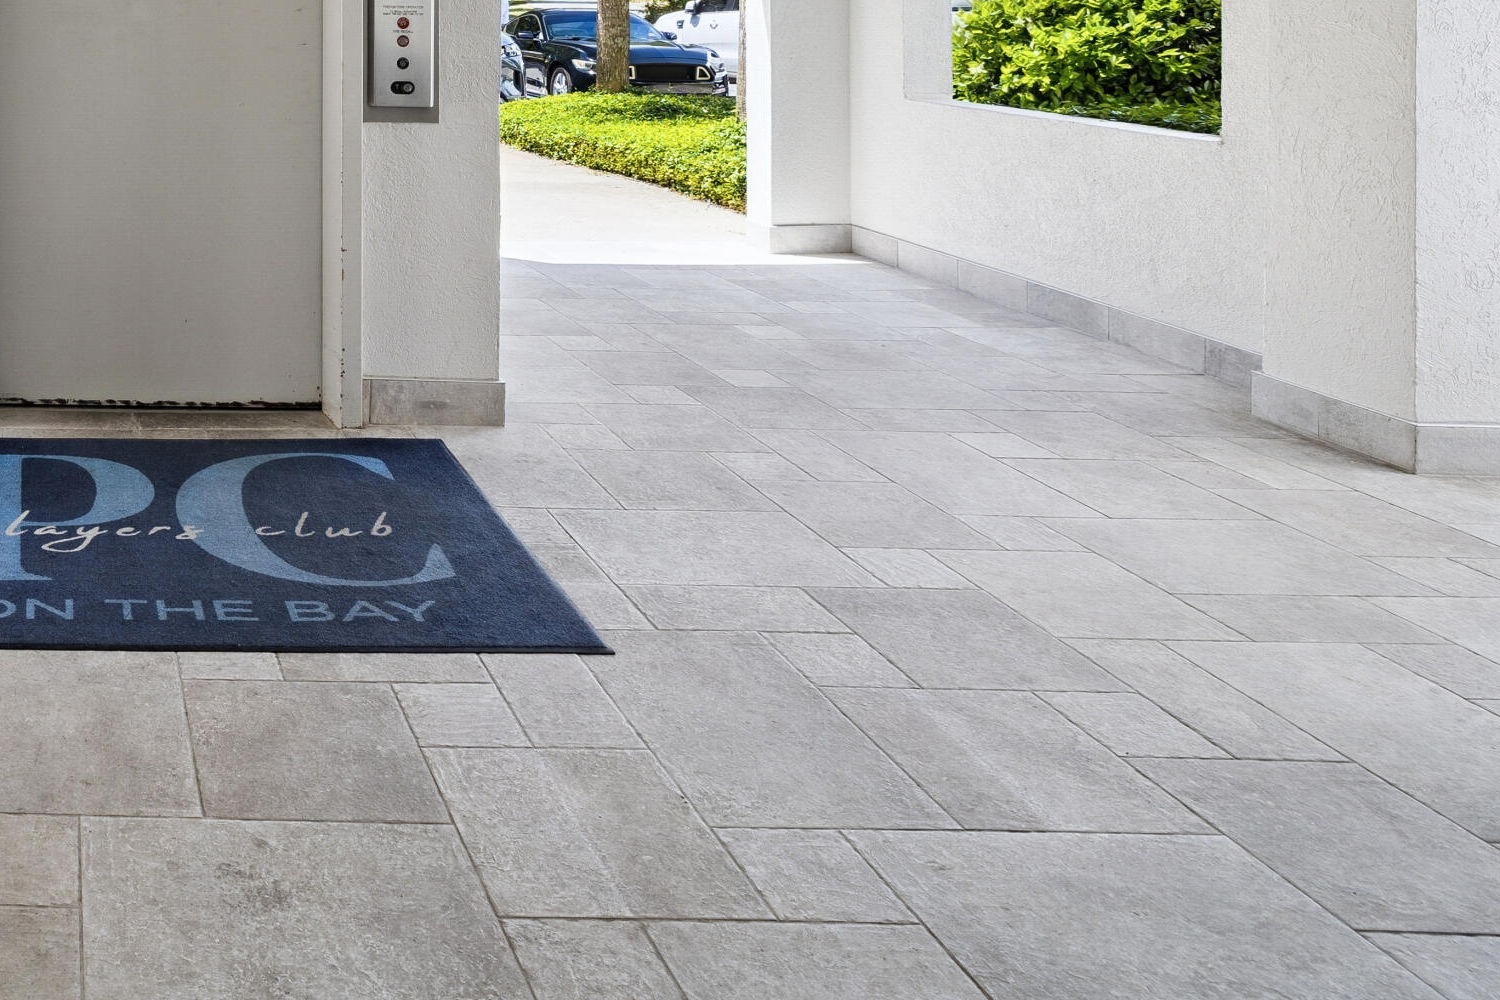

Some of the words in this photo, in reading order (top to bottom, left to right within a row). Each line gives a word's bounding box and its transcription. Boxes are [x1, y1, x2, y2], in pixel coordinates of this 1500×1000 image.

[255, 511, 394, 539] club
[104, 599, 259, 622] THE
[287, 600, 437, 624] BAY
